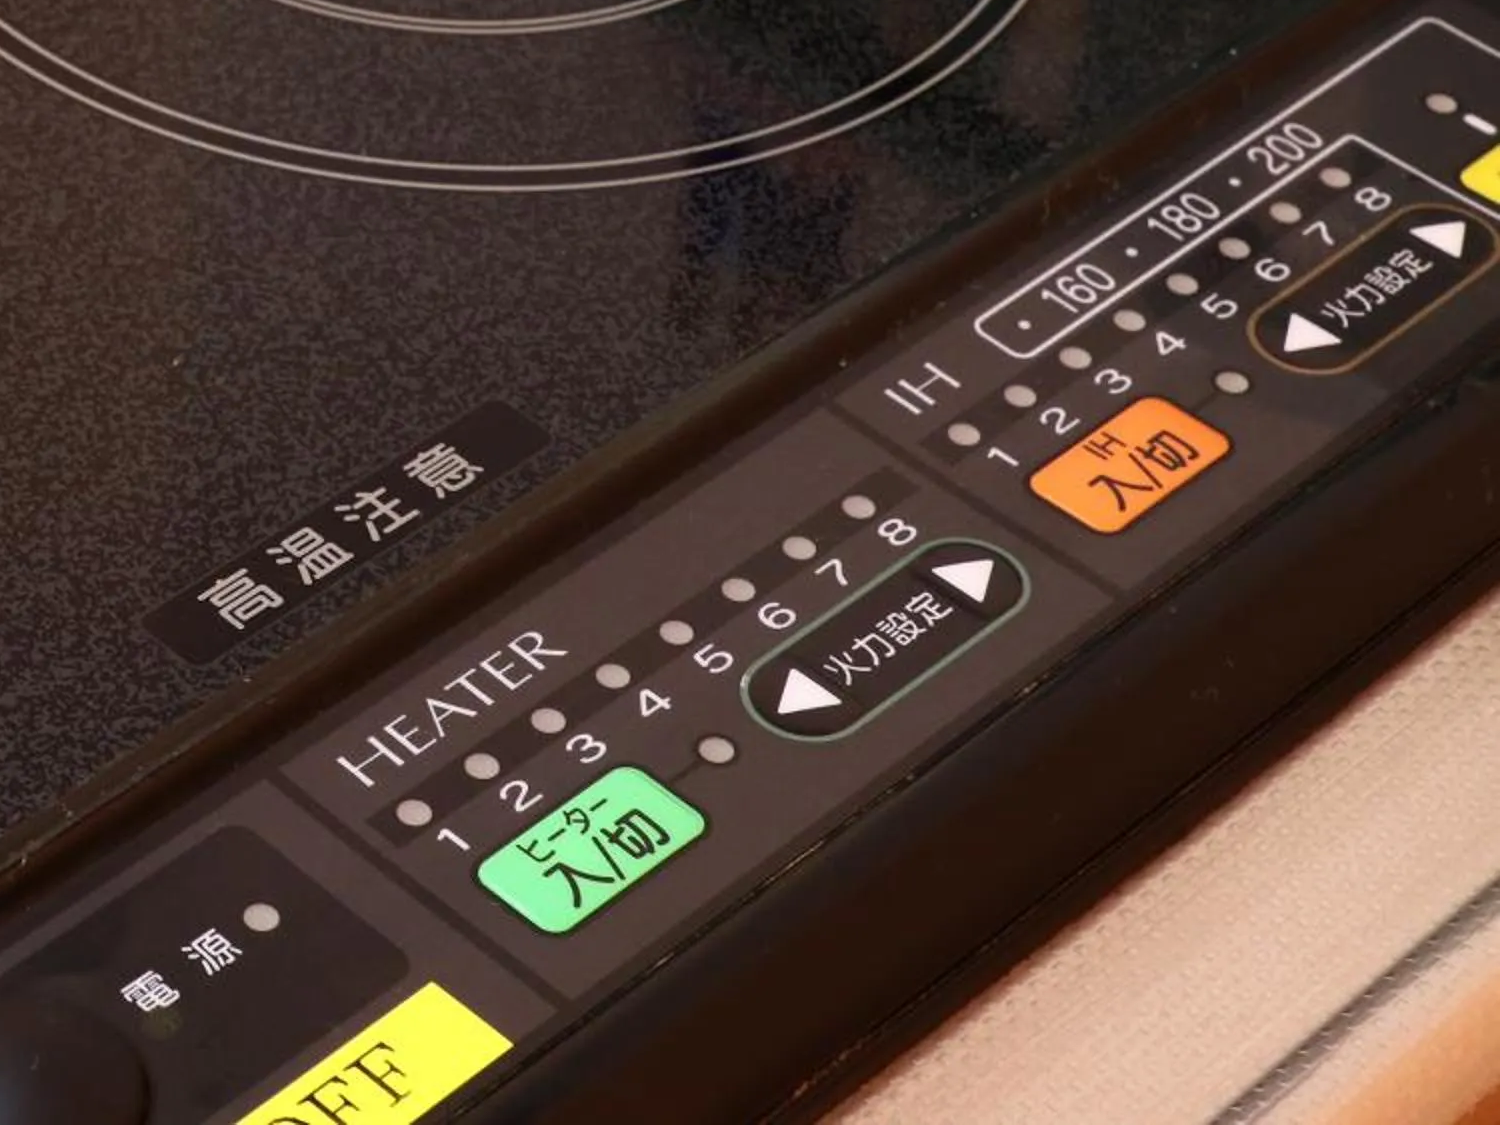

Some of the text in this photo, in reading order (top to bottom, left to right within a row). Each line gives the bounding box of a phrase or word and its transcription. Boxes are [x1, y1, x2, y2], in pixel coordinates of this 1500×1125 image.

[1041, 122, 1324, 314] 160 180 200
[988, 187, 1391, 466] 1 2 3 4 5 6 7 8
[1322, 248, 1433, 328] 火力設定
[884, 363, 960, 414] IH
[1082, 431, 1128, 461] IH
[1087, 429, 1201, 512] 入/切
[198, 443, 484, 629] 高温注意
[823, 590, 954, 686] 火力設定
[337, 630, 569, 788] HEATER
[438, 519, 916, 850] 1 2 3 4 5 6 7 8
[516, 798, 608, 862] ヒーター
[542, 808, 671, 909] 入/切
[121, 928, 242, 1011] 電源
[267, 1042, 412, 1125] FF
